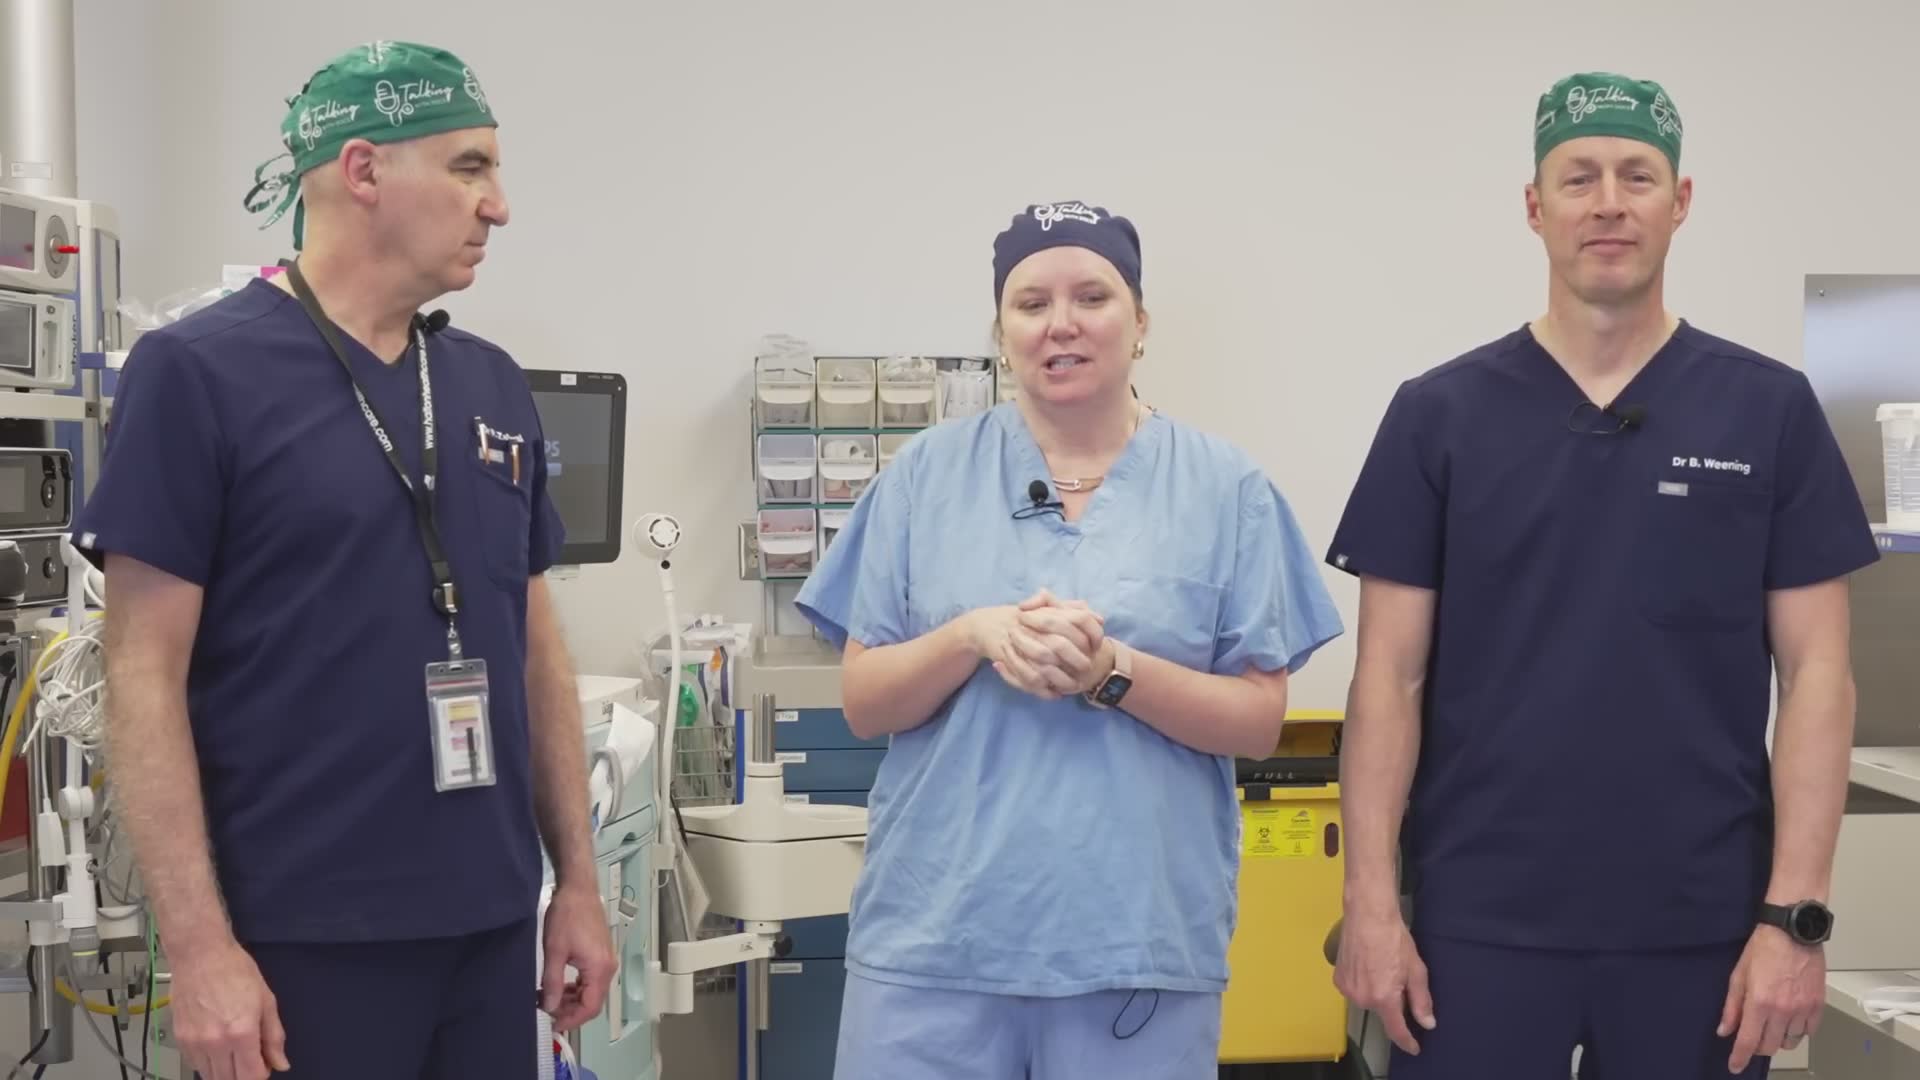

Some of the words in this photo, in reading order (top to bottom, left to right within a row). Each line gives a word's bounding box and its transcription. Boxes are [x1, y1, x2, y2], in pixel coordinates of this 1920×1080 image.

[399, 78, 454, 104] Talking
[1588, 85, 1640, 111] Talking
[311, 99, 361, 125] Talking
[1672, 456, 1687, 467] Dr
[1689, 457, 1702, 468] B.
[1704, 458, 1751, 475] Weening
[1253, 772, 1297, 780] FULL
